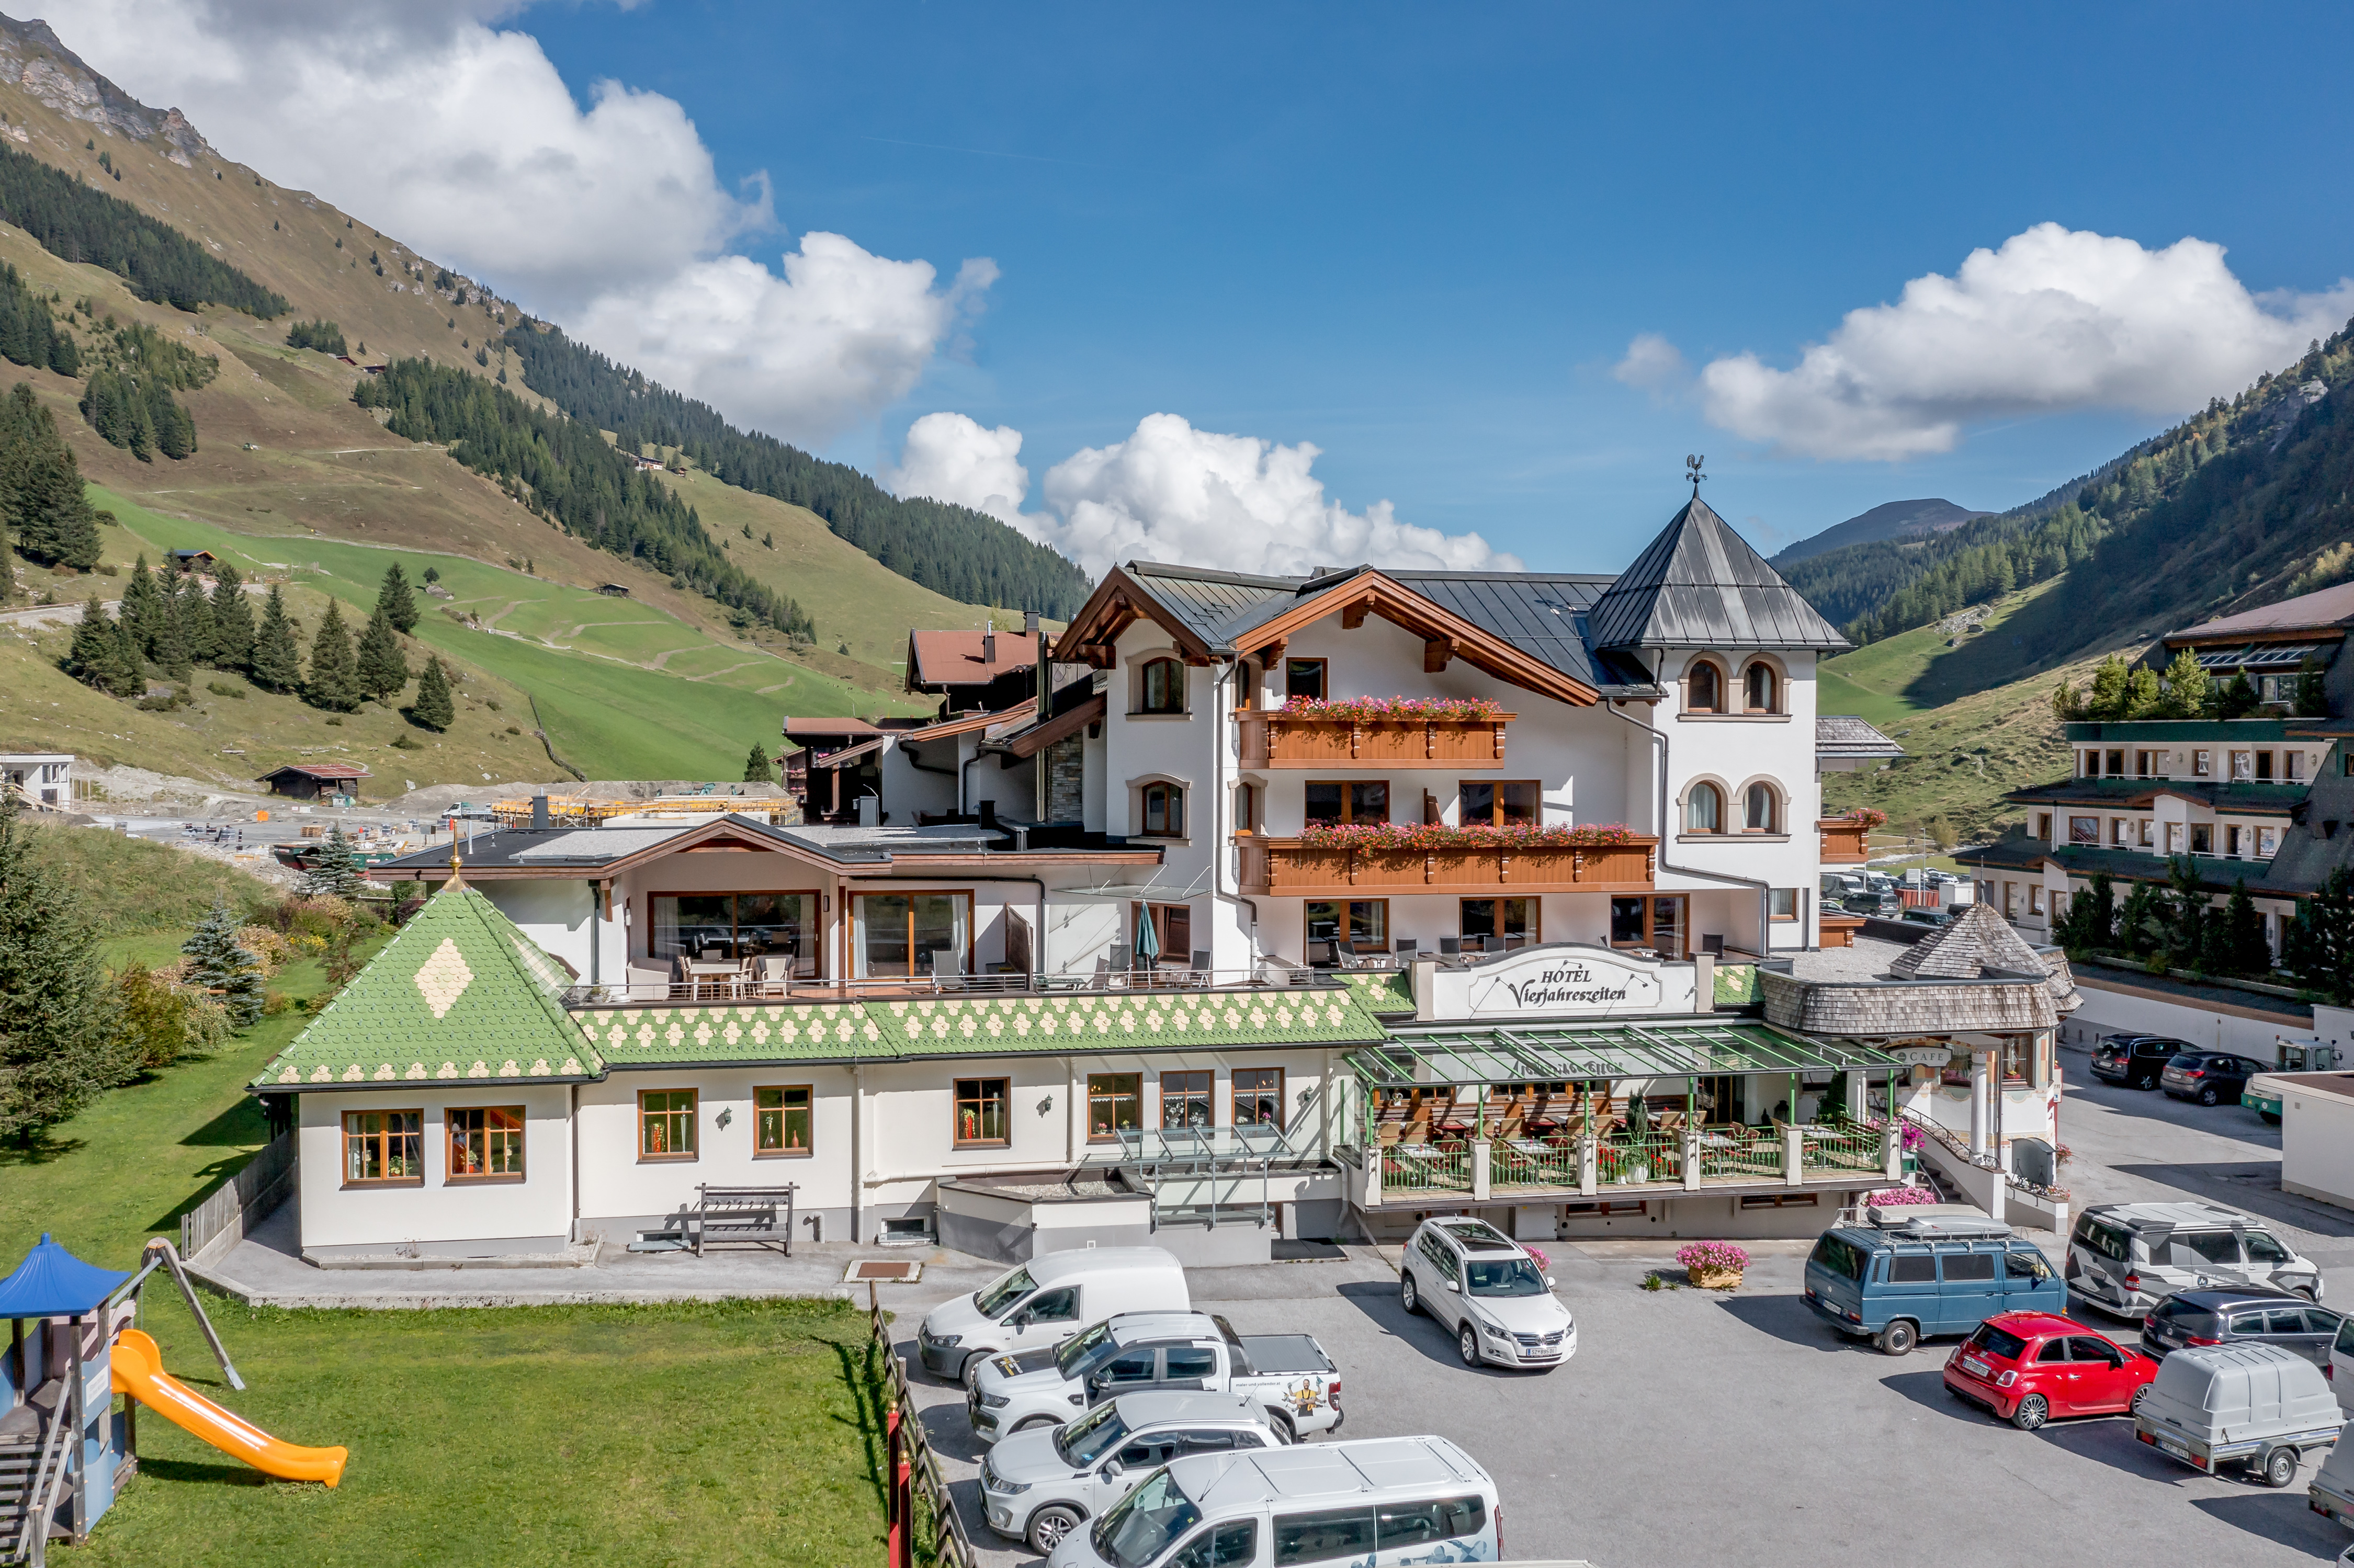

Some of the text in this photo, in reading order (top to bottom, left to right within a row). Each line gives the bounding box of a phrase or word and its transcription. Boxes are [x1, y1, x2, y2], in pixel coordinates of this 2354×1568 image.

[1540, 970, 1592, 983] HOTEL
[1508, 979, 1626, 1008] Vierjahreszeiten
[1910, 1052, 1943, 1061] CAFE
